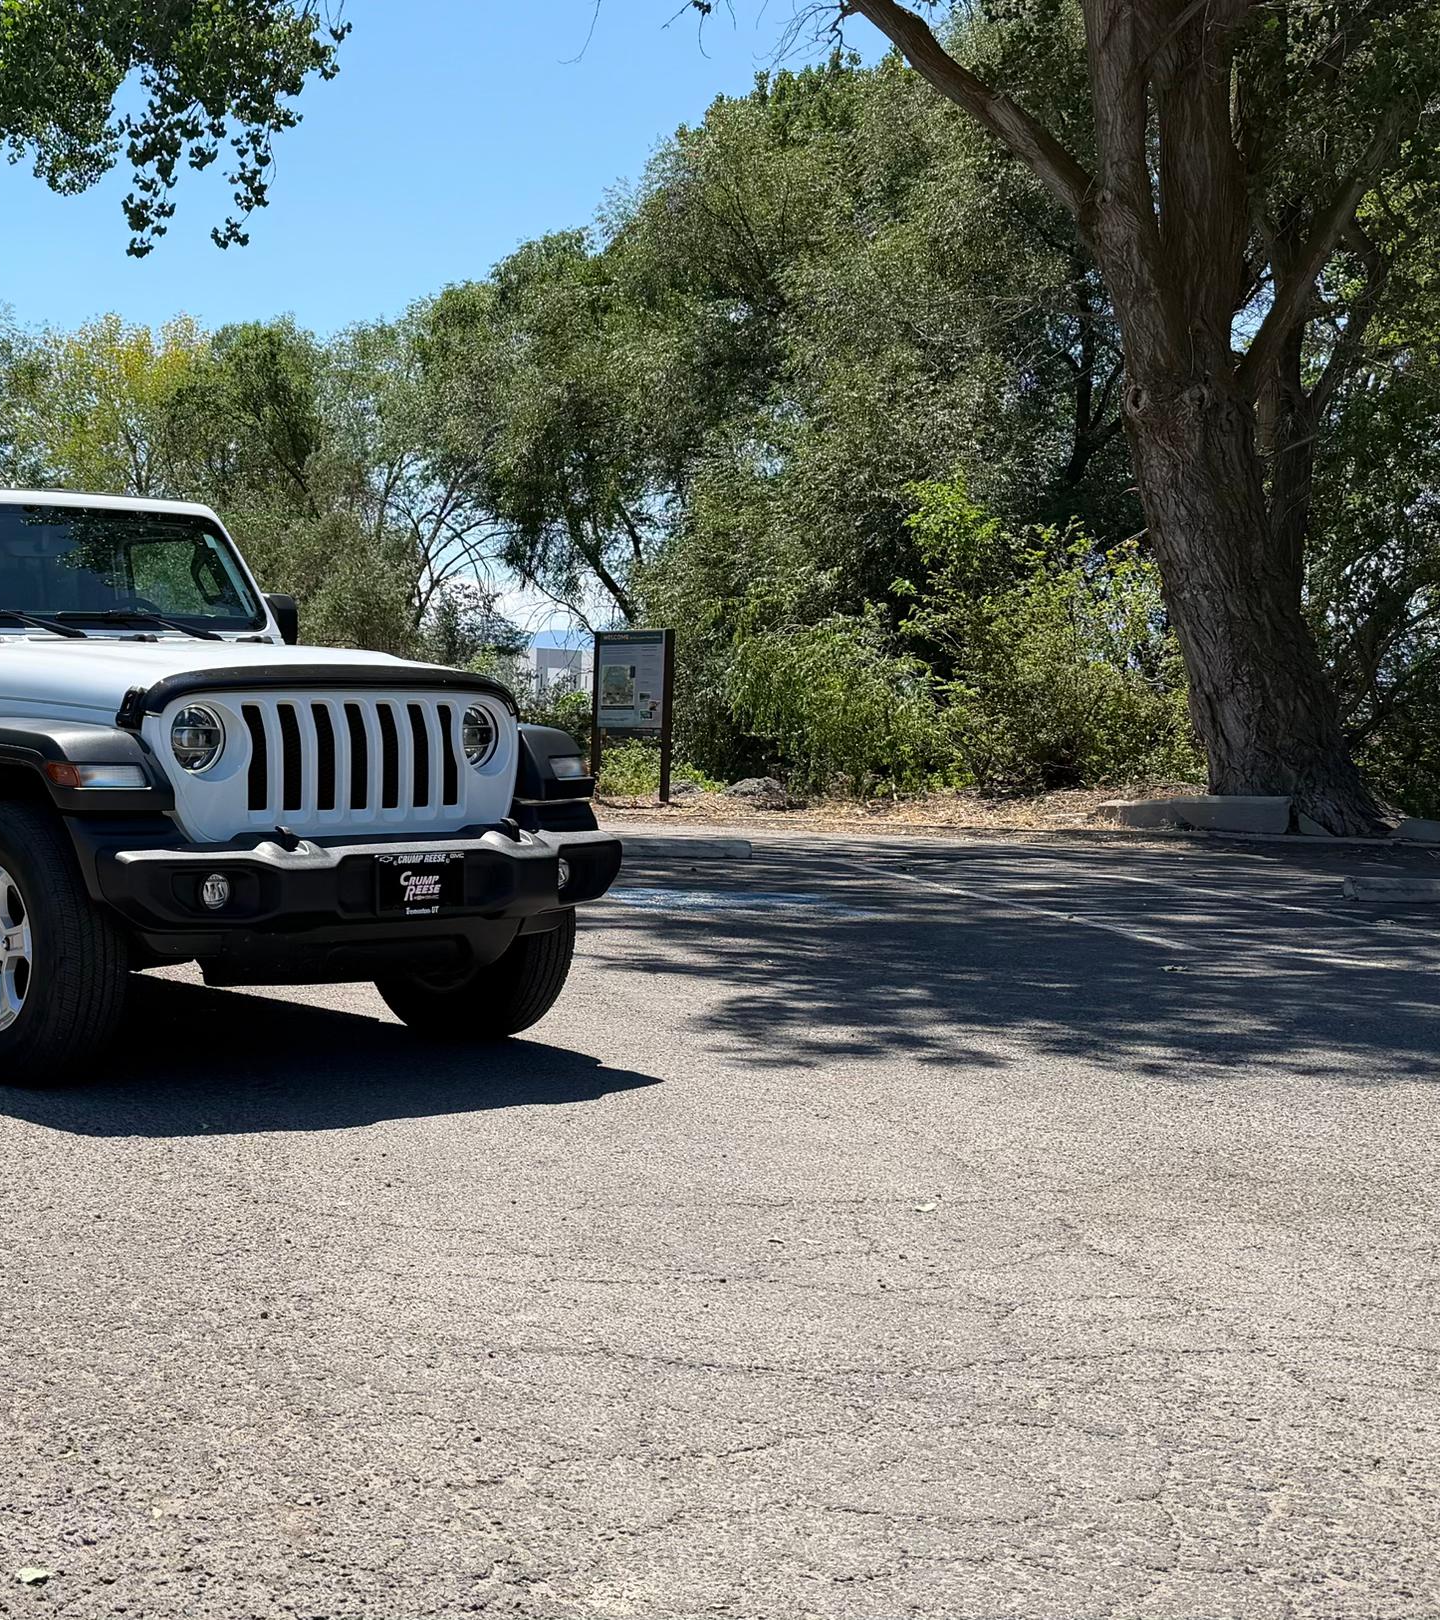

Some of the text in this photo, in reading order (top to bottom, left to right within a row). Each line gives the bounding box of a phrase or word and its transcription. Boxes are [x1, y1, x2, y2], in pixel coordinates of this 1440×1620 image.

[398, 854, 446, 863] CRUMP REESE
[400, 871, 439, 886] CRUMP
[404, 884, 442, 901] REESE
